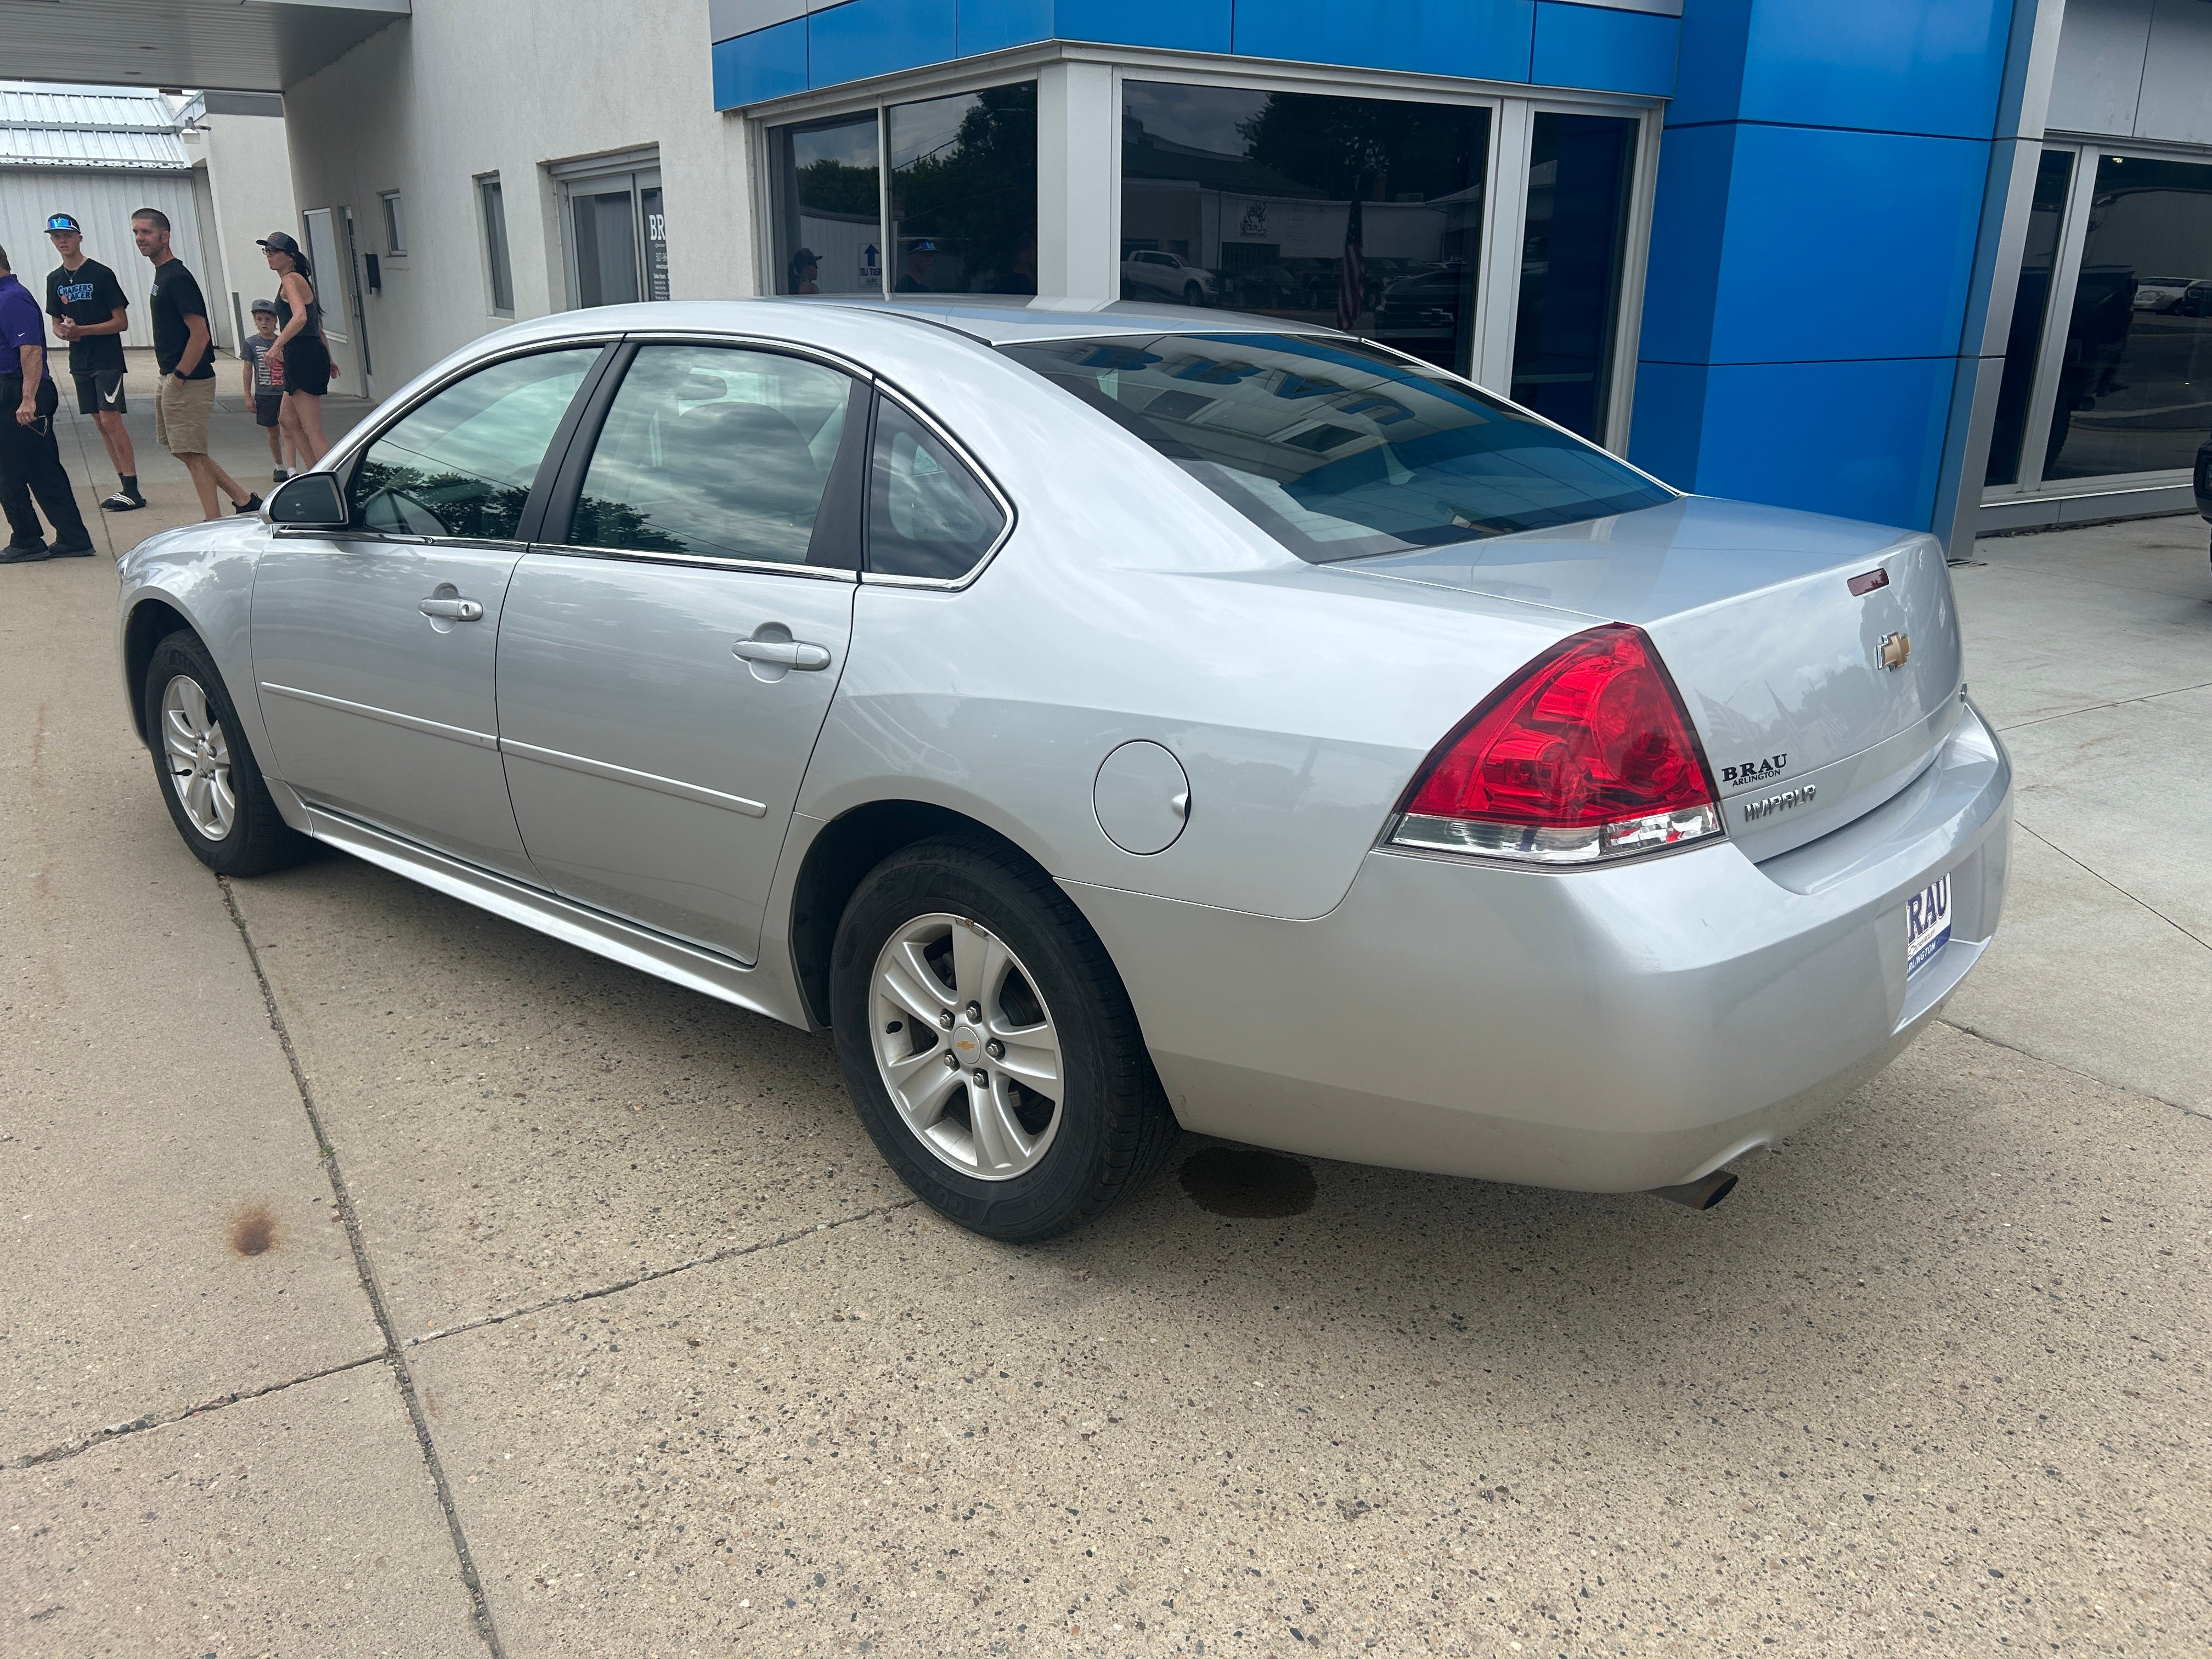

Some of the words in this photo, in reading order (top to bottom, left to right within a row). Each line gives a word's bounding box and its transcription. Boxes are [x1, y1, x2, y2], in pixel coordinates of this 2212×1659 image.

[1721, 753, 1787, 782] BRAU
[1732, 769, 1781, 787] ARLINGTON
[1744, 784, 1816, 822] IMPALA
[1908, 940, 1936, 972] RLINGTON
